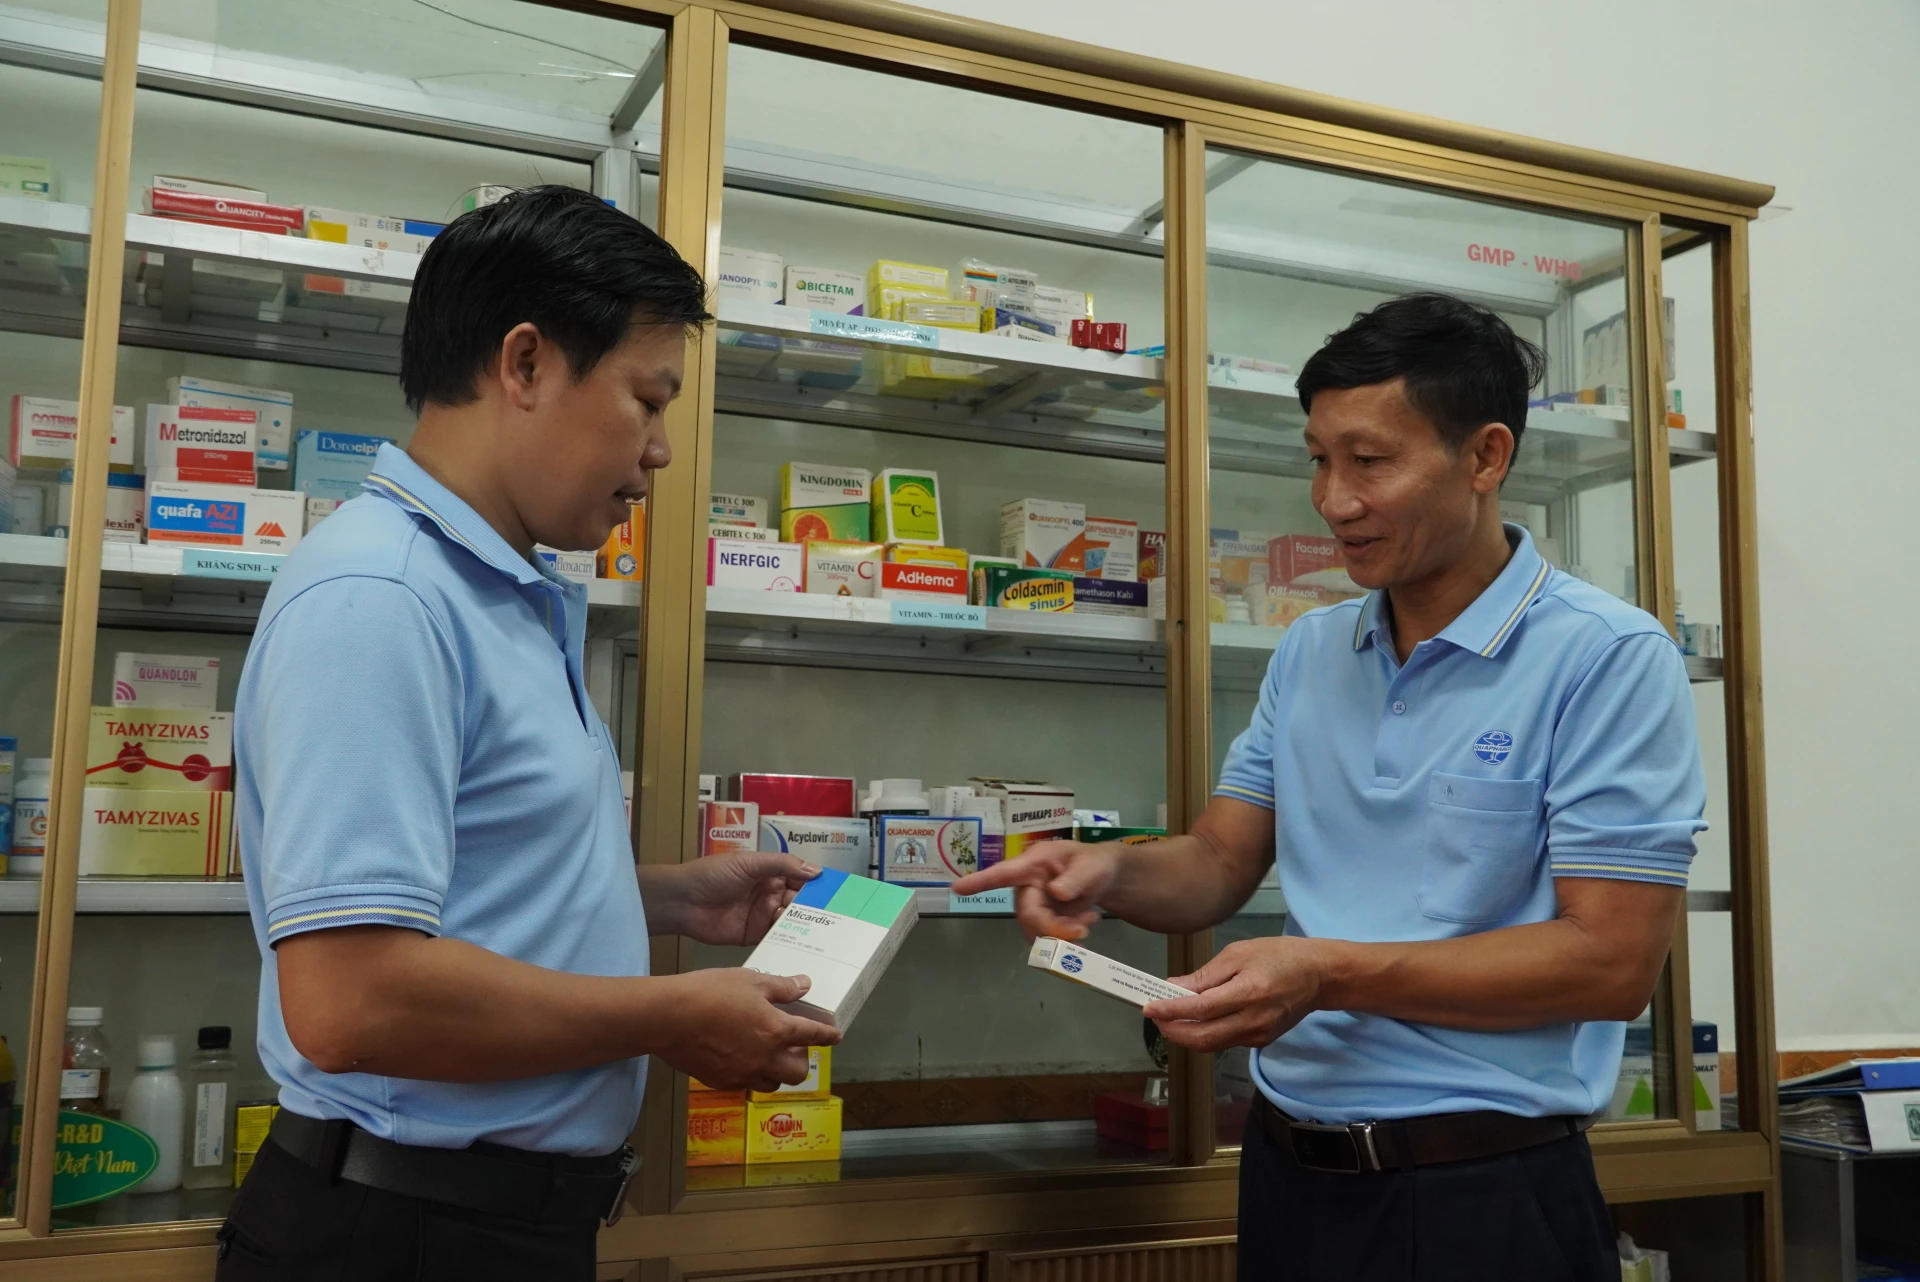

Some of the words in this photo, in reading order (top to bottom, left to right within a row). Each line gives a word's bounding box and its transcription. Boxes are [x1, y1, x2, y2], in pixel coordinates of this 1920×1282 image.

[1467, 243, 1516, 267] GMP
[1534, 255, 1582, 279] WHO
[160, 423, 247, 445] Metronidazol
[800, 474, 863, 489] KINGDOMIN
[157, 503, 202, 519] quafa
[206, 504, 238, 521] AZI
[1071, 519, 1085, 527] 400
[712, 529, 742, 539] CEBITEX
[260, 538, 281, 547] 250mg
[197, 559, 235, 571] KHÁNG
[237, 563, 262, 573] SINH
[720, 552, 780, 569] NERFGIC
[817, 562, 855, 573] VITAMIN
[857, 561, 874, 580] C
[1004, 578, 1065, 601] Coldacmin
[1029, 597, 1065, 611] sinus
[899, 610, 932, 619] VITAMIN
[940, 610, 967, 621] THUỐC
[139, 667, 198, 681] QUANOLON
[105, 722, 210, 740] TAMYZIVAS
[95, 810, 200, 826] TAMYZIVAS
[1011, 809, 1053, 824] GLUPHAKAPS
[711, 828, 752, 839] CALCICHEW
[788, 830, 828, 845] Acyclovir
[830, 833, 846, 844] 200
[846, 835, 859, 846] mg
[887, 828, 935, 837] QUANCARDIO
[957, 895, 984, 904] THUỐC
[985, 895, 1007, 904] KHÁC
[792, 924, 811, 937] mg
[1620, 1068, 1652, 1076] ZITROM
[95, 1150, 138, 1174] Nam
